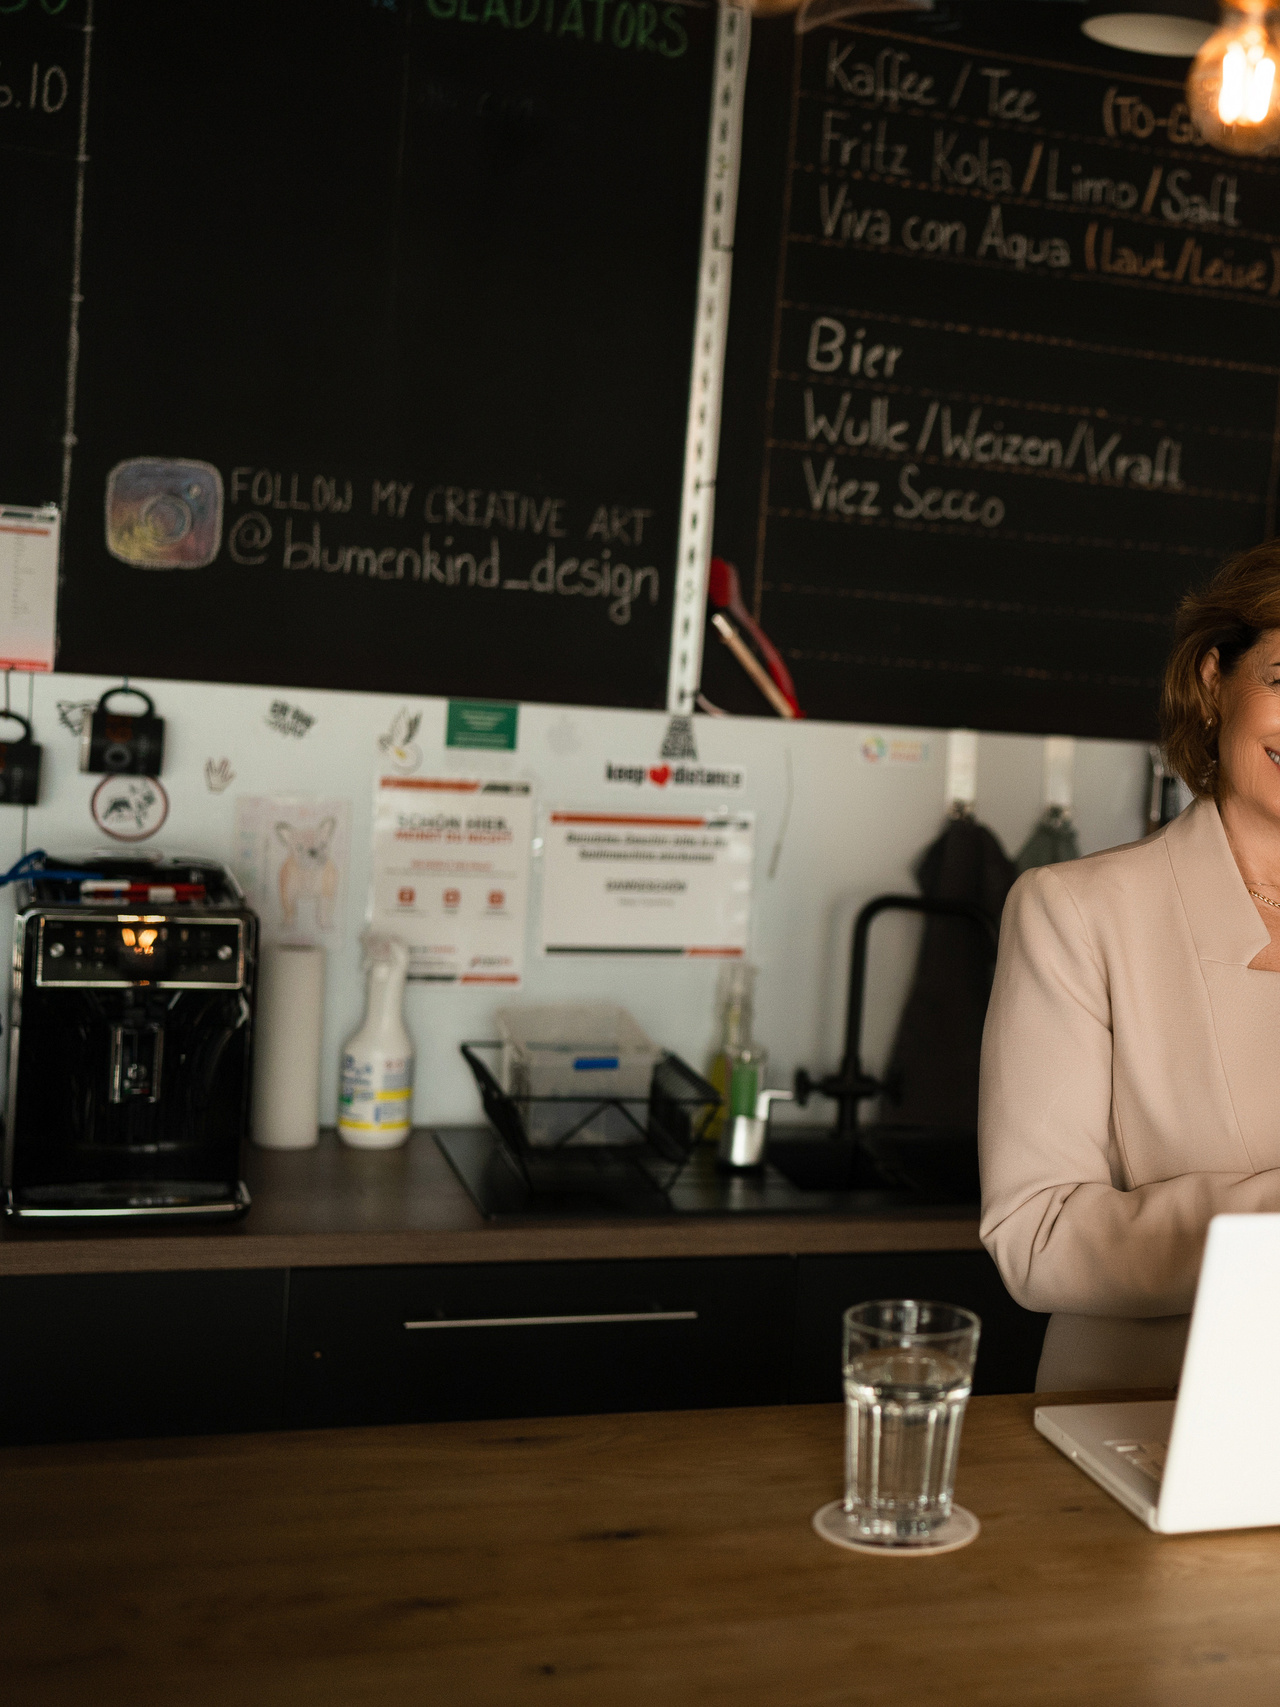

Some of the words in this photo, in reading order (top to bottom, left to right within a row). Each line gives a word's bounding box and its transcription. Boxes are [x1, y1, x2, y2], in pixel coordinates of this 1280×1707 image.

[825, 38, 938, 107] Kaffee
[979, 67, 1041, 122] Tee
[819, 109, 911, 177] Fritz
[819, 184, 891, 245] Viva
[902, 215, 967, 255] con
[977, 204, 1082, 270] Aqua
[807, 316, 903, 378] Bier
[231, 466, 353, 513] FOLLOW
[372, 479, 413, 519] MY
[425, 485, 566, 539] CREATIVE
[586, 505, 653, 546] ART
[802, 456, 882, 516] Viez
[893, 463, 1005, 528] Secco
